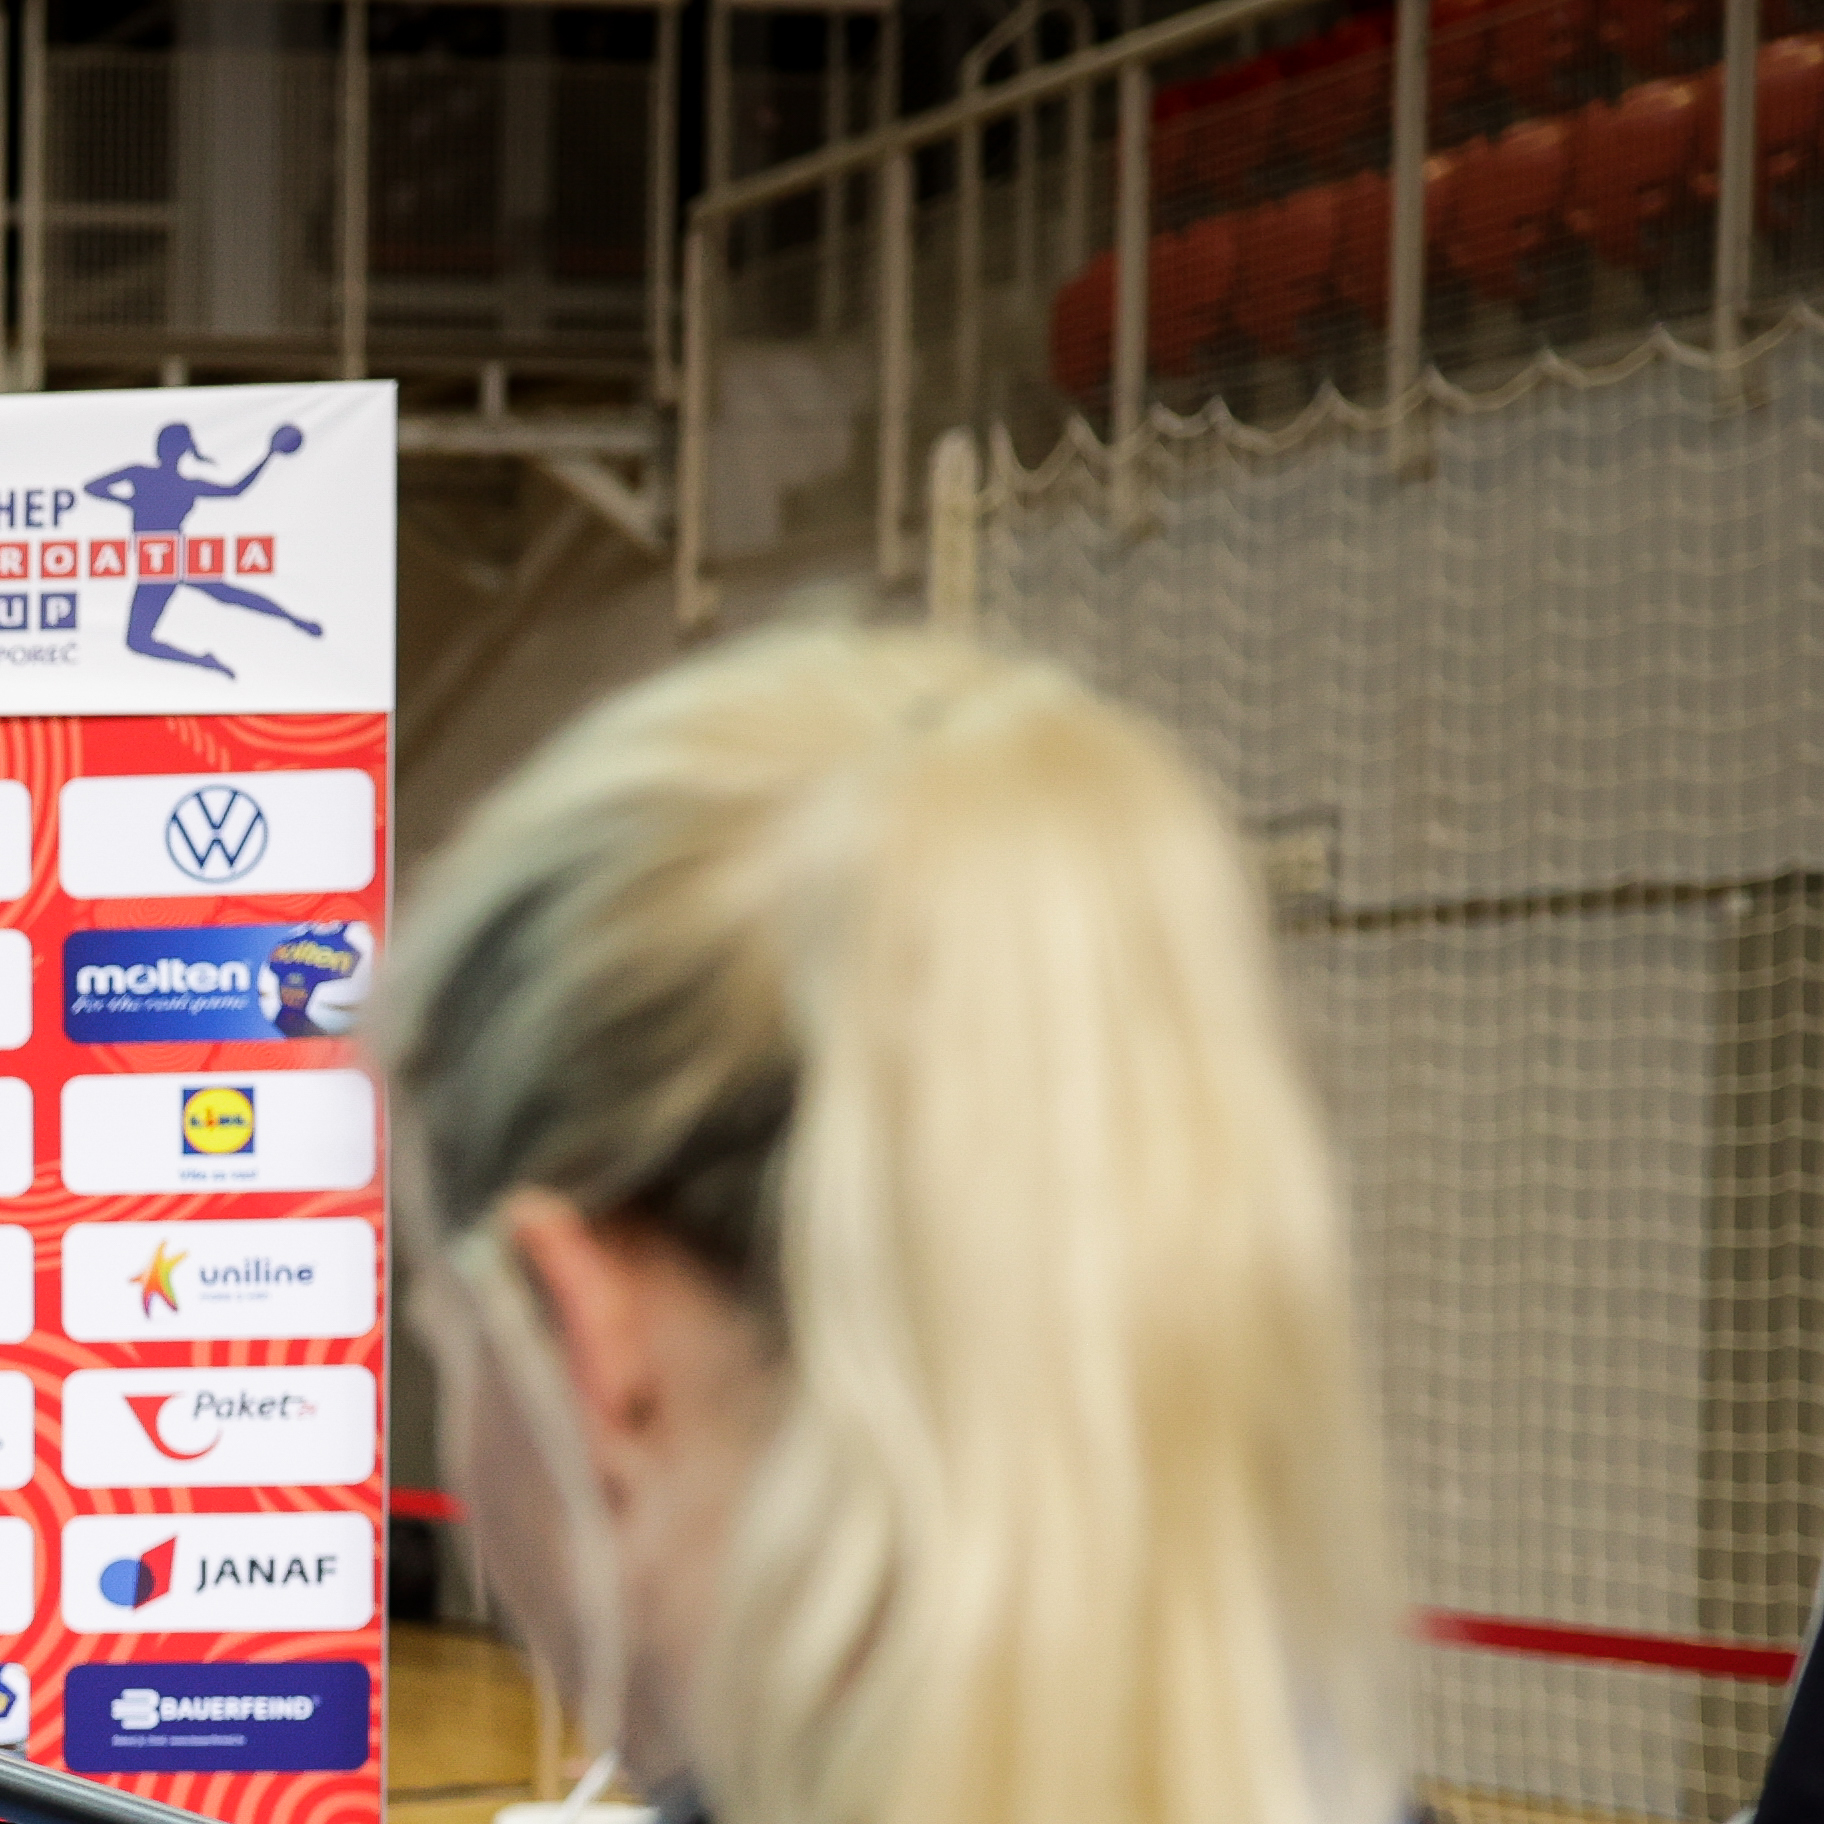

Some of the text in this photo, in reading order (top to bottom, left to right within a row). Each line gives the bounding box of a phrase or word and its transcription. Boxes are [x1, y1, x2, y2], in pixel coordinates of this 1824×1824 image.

[75, 957, 251, 995] molten
[200, 1260, 314, 1284] uniline
[194, 1555, 339, 1593] JANAF
[160, 1695, 314, 1722] BAUERFEIND
